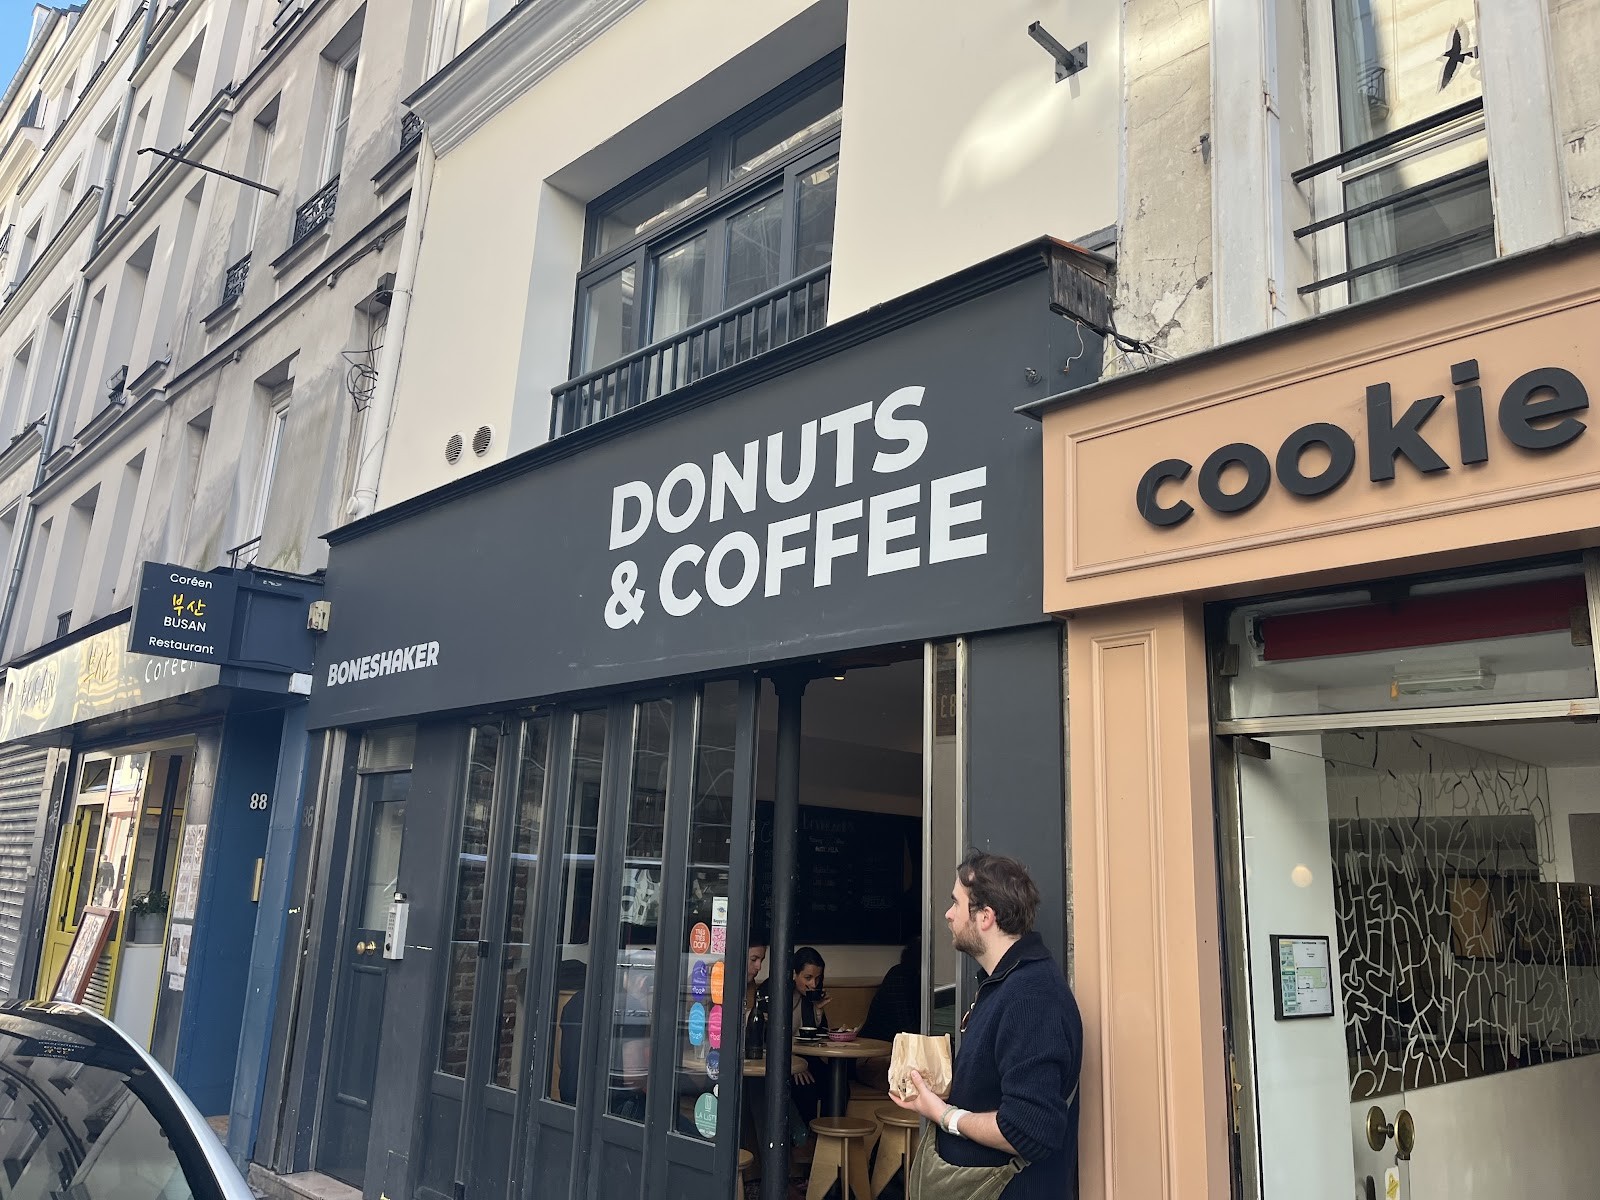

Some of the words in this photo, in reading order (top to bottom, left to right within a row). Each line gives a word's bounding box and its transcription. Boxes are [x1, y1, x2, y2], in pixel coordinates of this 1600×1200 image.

[1136, 358, 1590, 527] cookie
[609, 385, 928, 550] DONUTS
[604, 560, 646, 630] &
[659, 466, 988, 617] COFFEE
[169, 573, 213, 589] Coréen
[172, 593, 206, 616] 부산
[163, 616, 206, 632] BUSAN
[149, 636, 214, 655] Restaurant
[326, 641, 440, 687] BONESHAKER
[250, 793, 268, 810] 88
